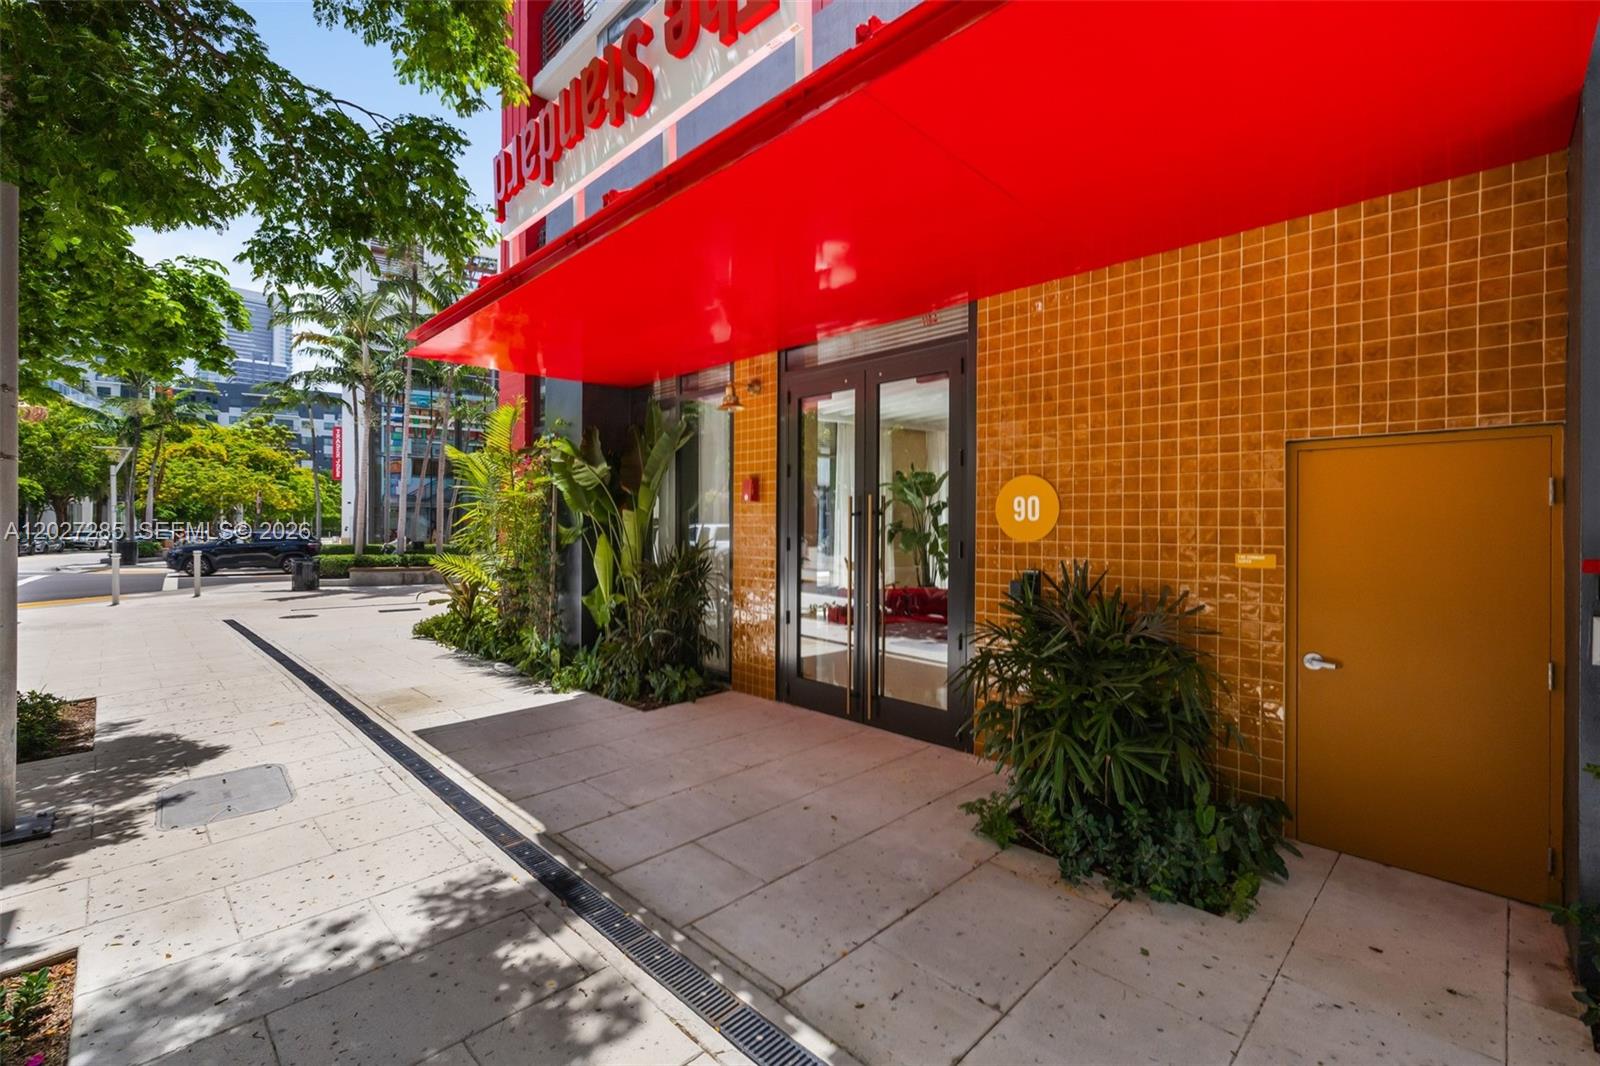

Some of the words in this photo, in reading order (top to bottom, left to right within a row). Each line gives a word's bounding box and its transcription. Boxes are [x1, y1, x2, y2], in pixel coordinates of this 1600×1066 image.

[664, 0, 780, 59] he
[493, 18, 654, 223] Standard
[1013, 495, 1040, 522] 90
